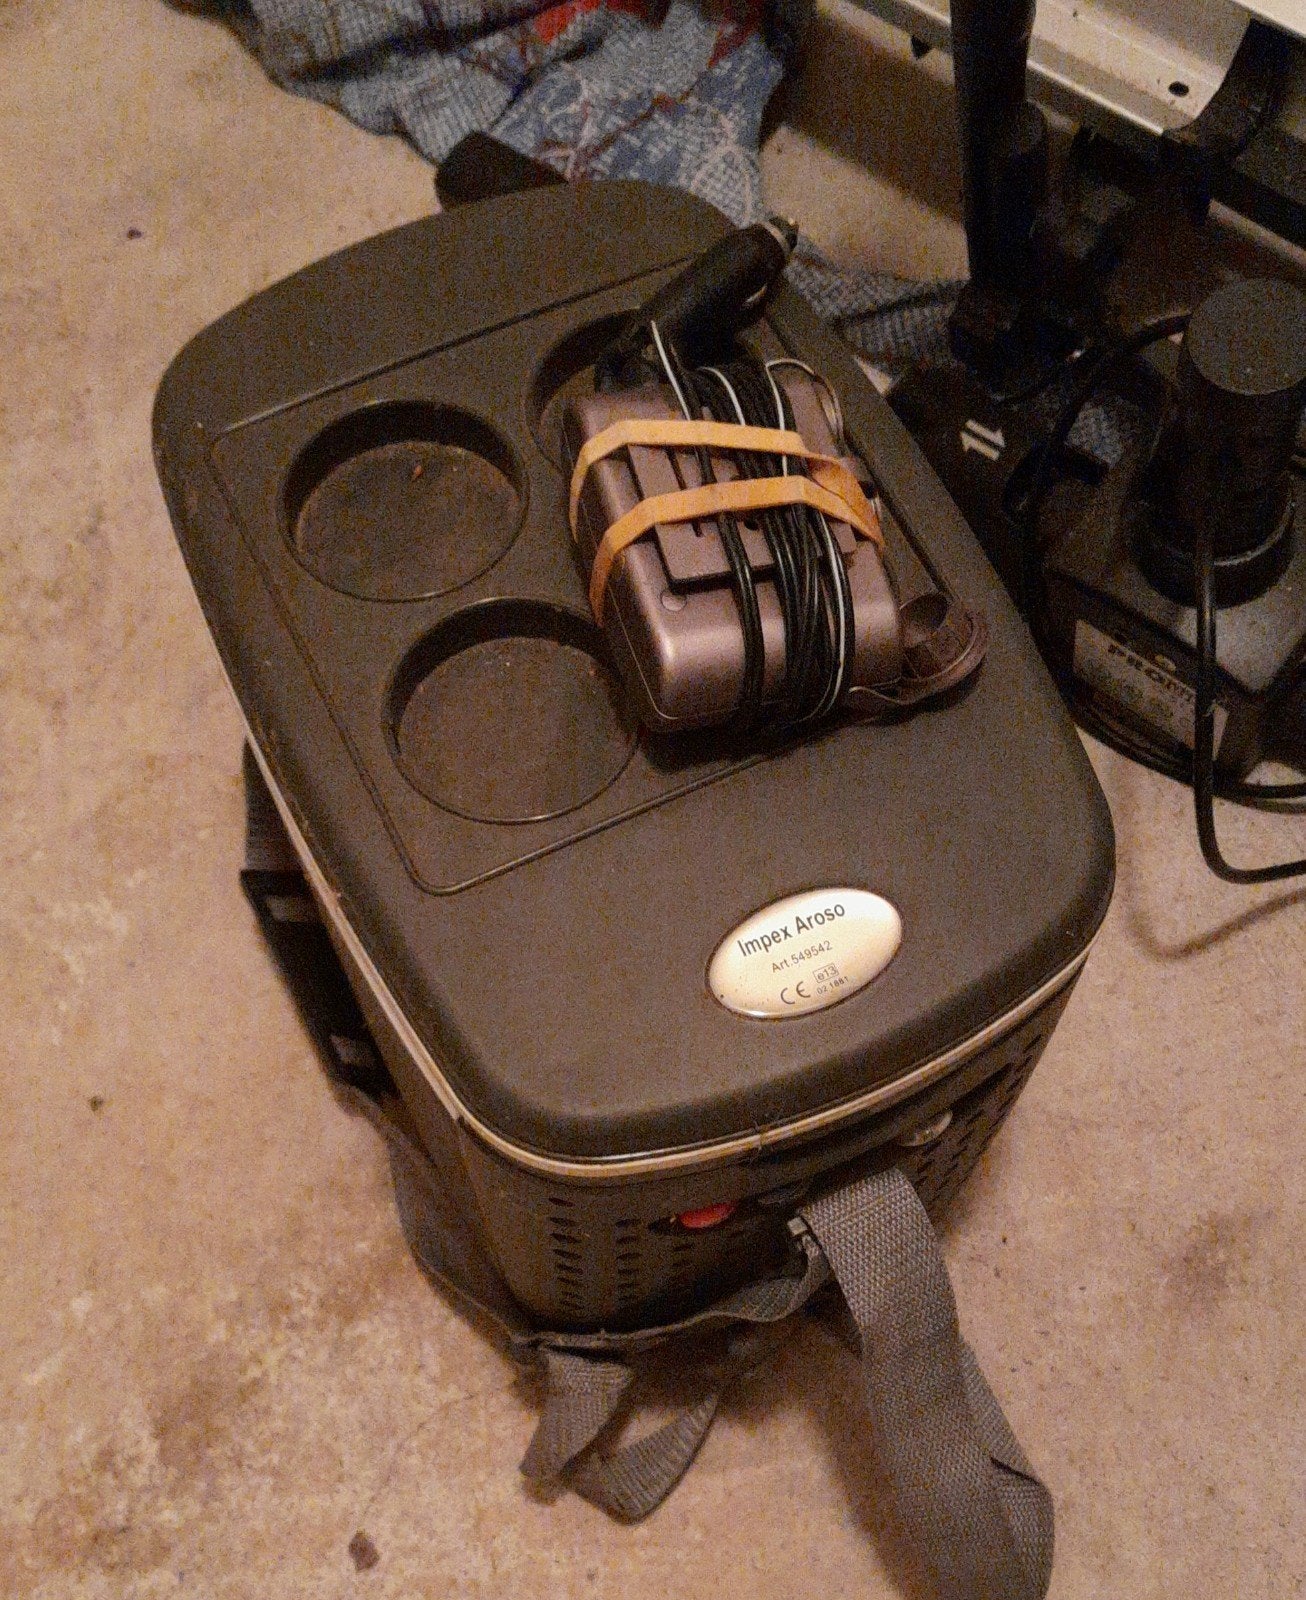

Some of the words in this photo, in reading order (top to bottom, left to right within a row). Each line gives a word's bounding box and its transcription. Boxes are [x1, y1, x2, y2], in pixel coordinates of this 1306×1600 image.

[738, 926, 792, 957] Impex
[796, 904, 846, 934] Aroso
[772, 940, 833, 973] Art.549542
[817, 966, 837, 981] e13
[780, 981, 811, 1004] CE
